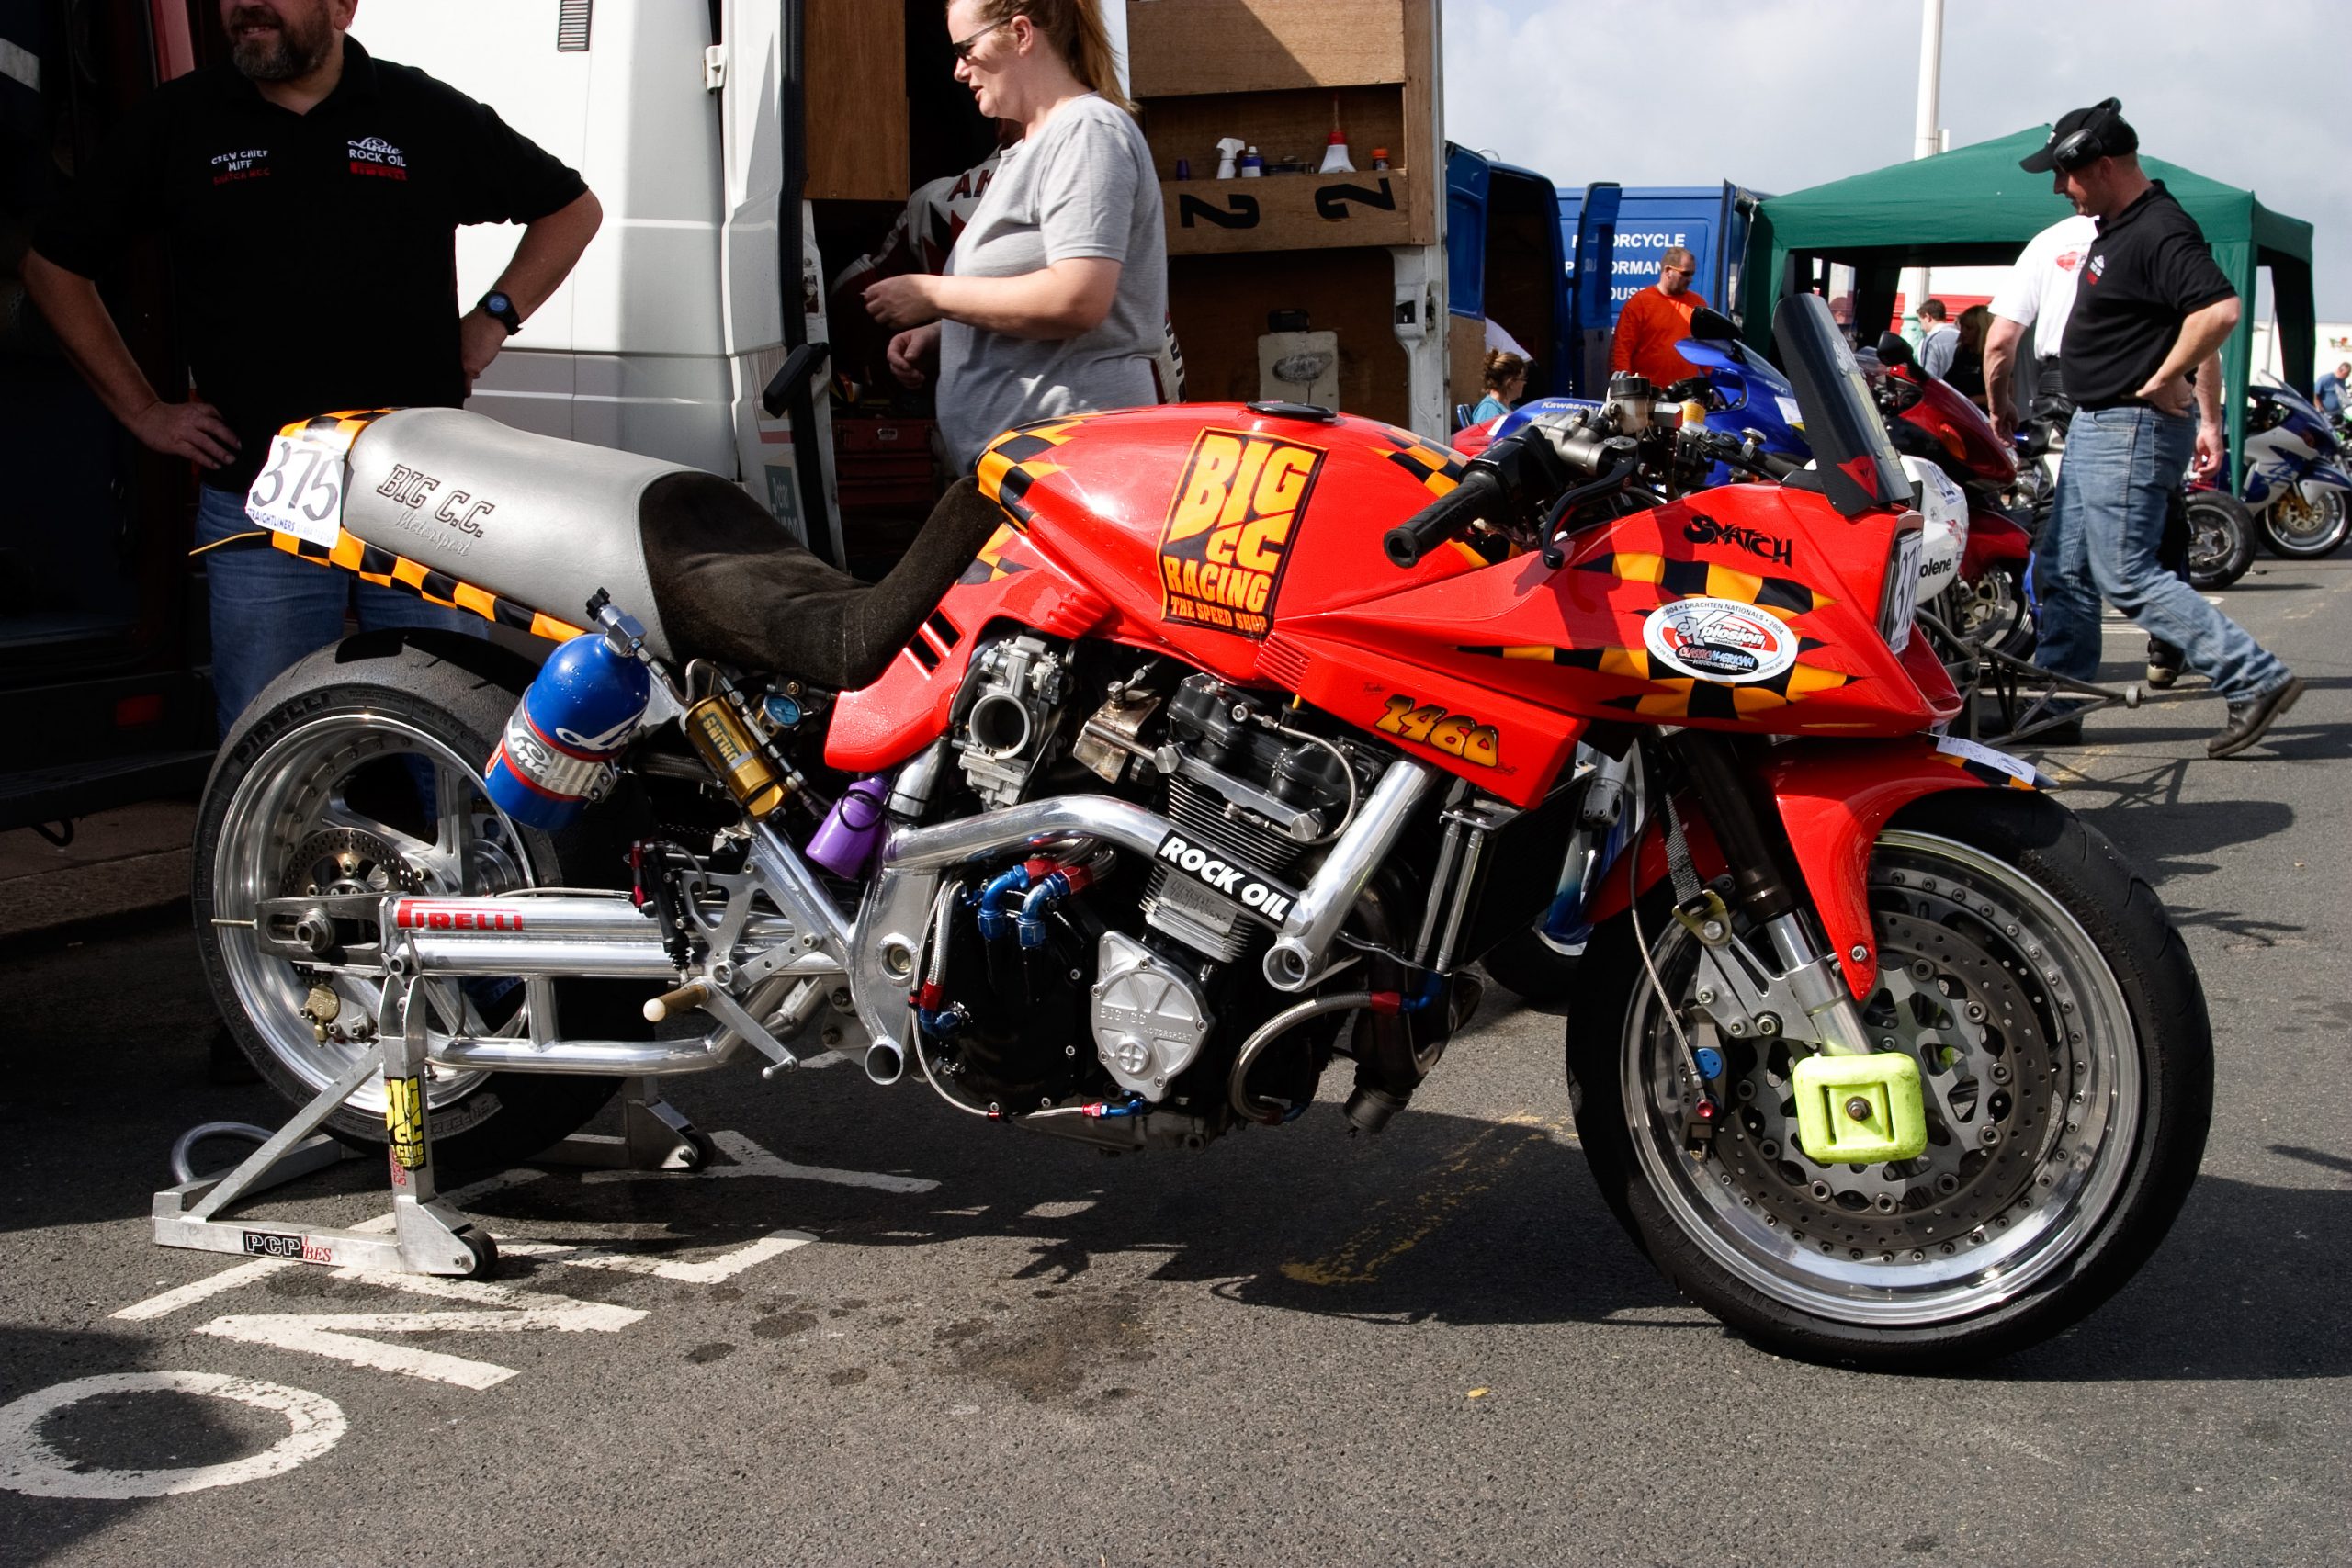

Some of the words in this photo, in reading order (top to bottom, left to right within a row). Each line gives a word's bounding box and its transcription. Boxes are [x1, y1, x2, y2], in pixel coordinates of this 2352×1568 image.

[211, 152, 237, 164] CREW
[240, 150, 268, 158] CHIEF
[347, 137, 404, 154] Linde
[349, 149, 383, 163] ROCK
[388, 155, 407, 167] OIL
[228, 160, 253, 172] MIFF
[1180, 194, 1260, 229] 2
[1315, 178, 1396, 220] 2
[252, 441, 338, 521] 375
[1167, 434, 1317, 544] BIG
[377, 464, 441, 509] BIG
[435, 490, 496, 538] C.C.
[1206, 511, 1294, 574] CC
[1683, 515, 1792, 569] SNATCH
[1163, 555, 1272, 613] RACING
[1919, 558, 1951, 579] olene
[1170, 595, 1195, 619] THE
[1196, 602, 1233, 632] SPEED
[1235, 612, 1268, 635] SHOP
[1725, 604, 1764, 621] NATIONALS
[1769, 621, 1783, 634] 2004
[1159, 836, 1245, 895] ROCK
[1241, 883, 1290, 922] OIL
[398, 900, 523, 931] PIRELLI
[390, 1144, 424, 1158] CING
[247, 1234, 301, 1256] PCP
[302, 1246, 331, 1263] BES
